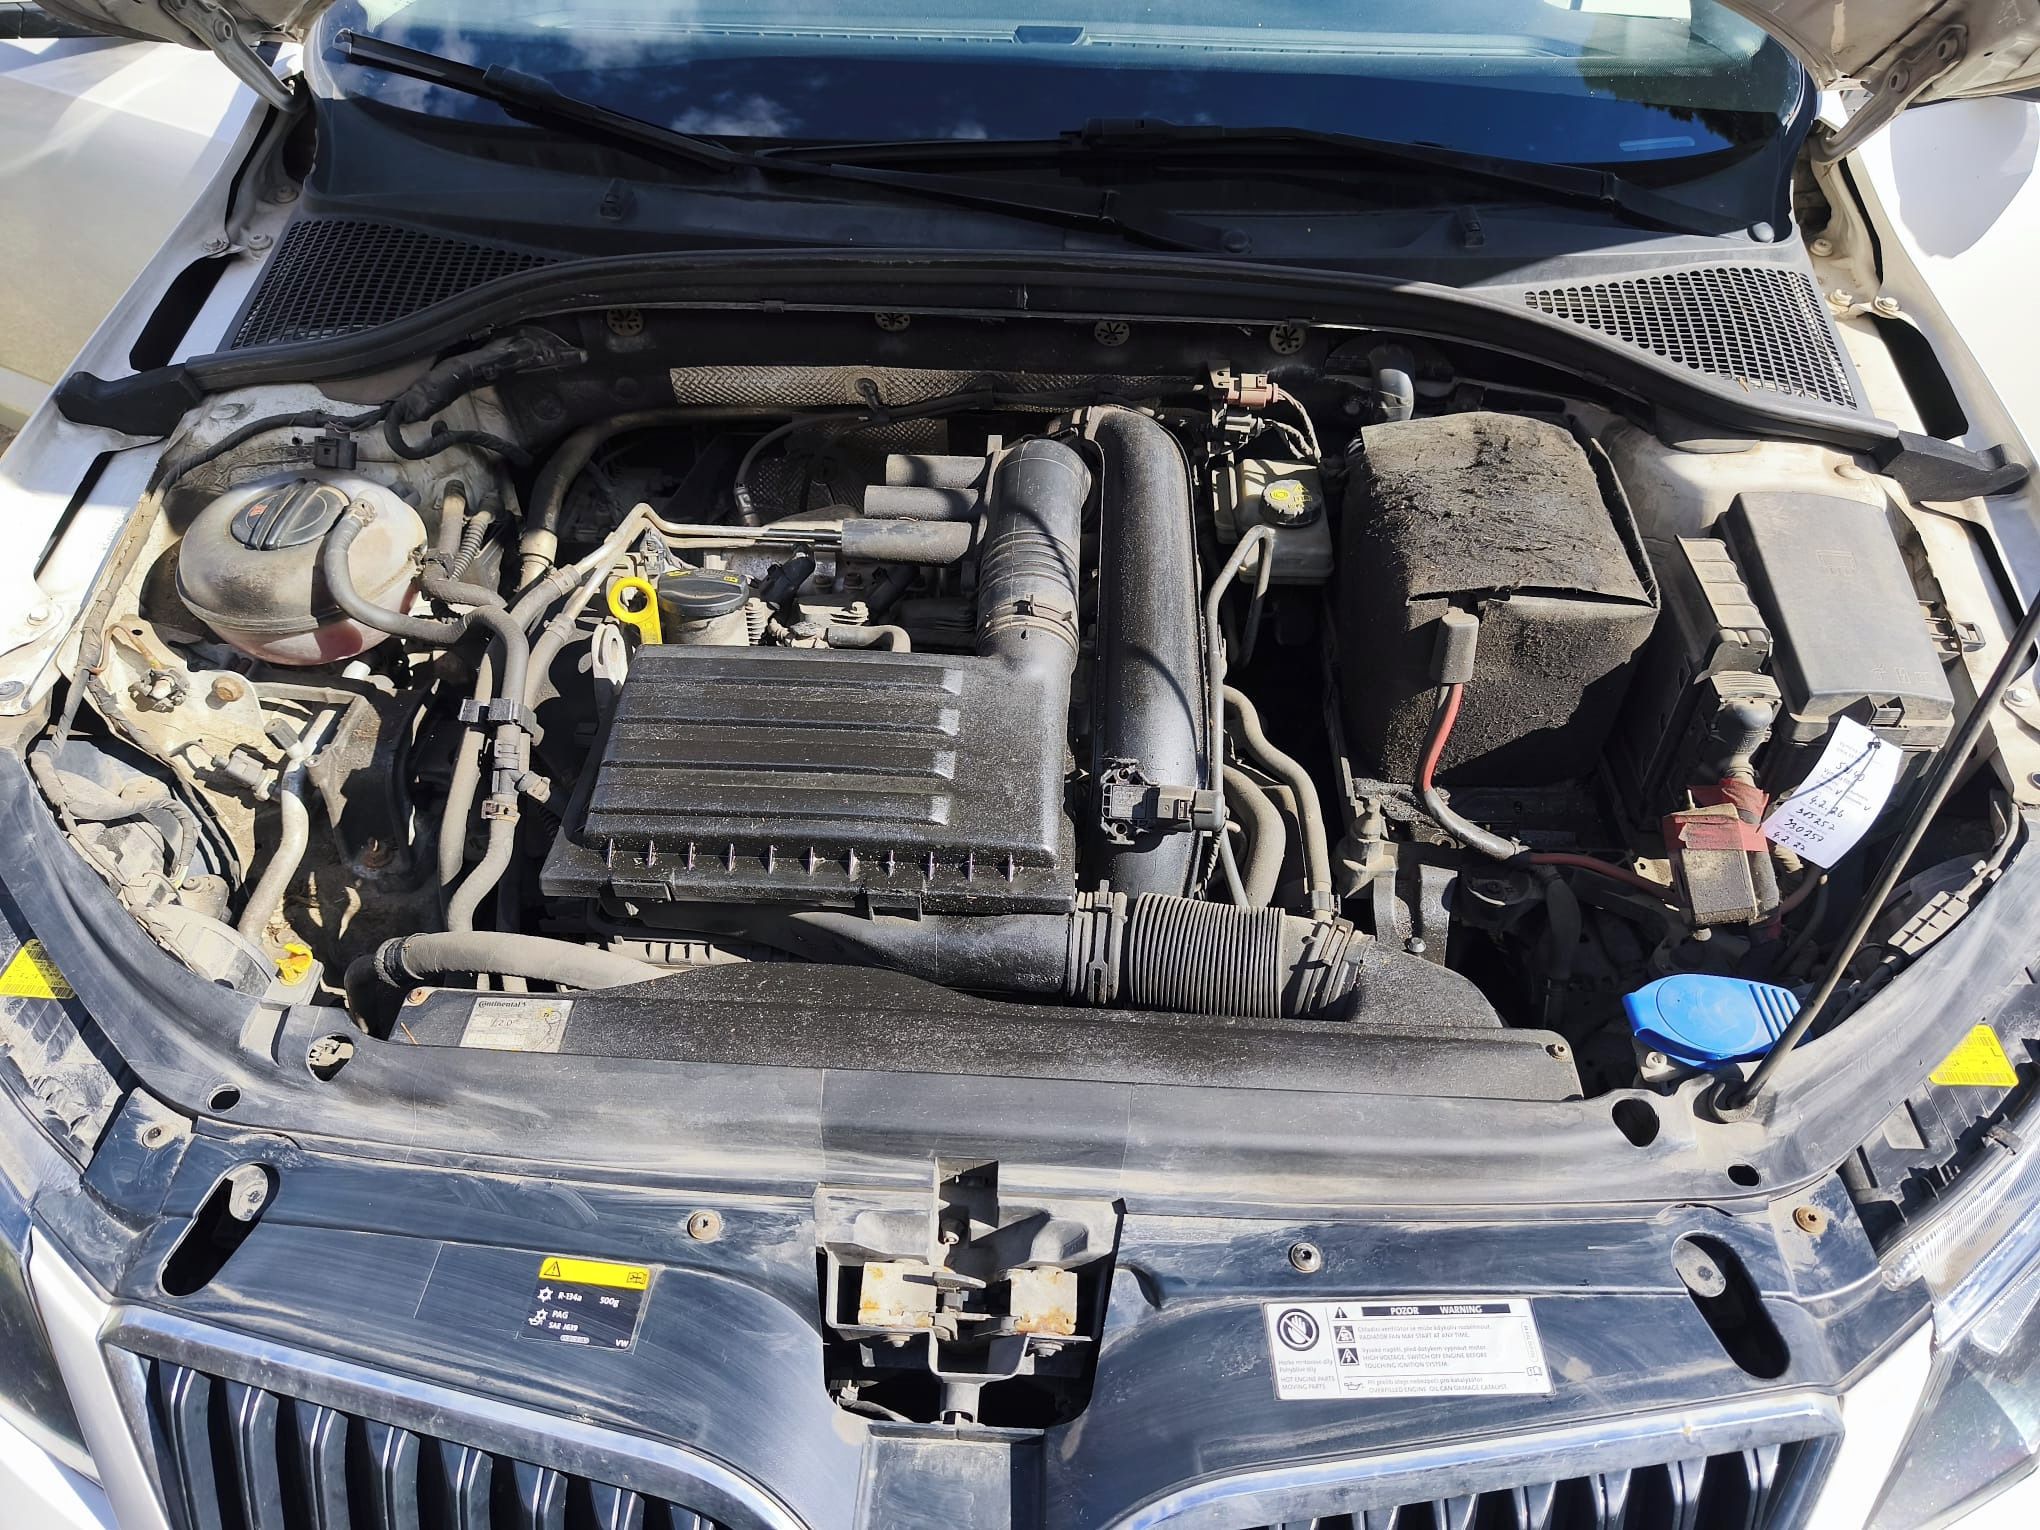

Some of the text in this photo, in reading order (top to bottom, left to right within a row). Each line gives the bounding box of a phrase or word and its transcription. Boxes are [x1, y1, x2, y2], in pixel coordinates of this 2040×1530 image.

[478, 1001, 521, 1009] Continental
[558, 1291, 620, 1308] R-134a 500g
[552, 1310, 569, 1319] PAG
[1390, 1305, 1483, 1315] POZOR WARNING
[615, 1339, 629, 1347] VW
